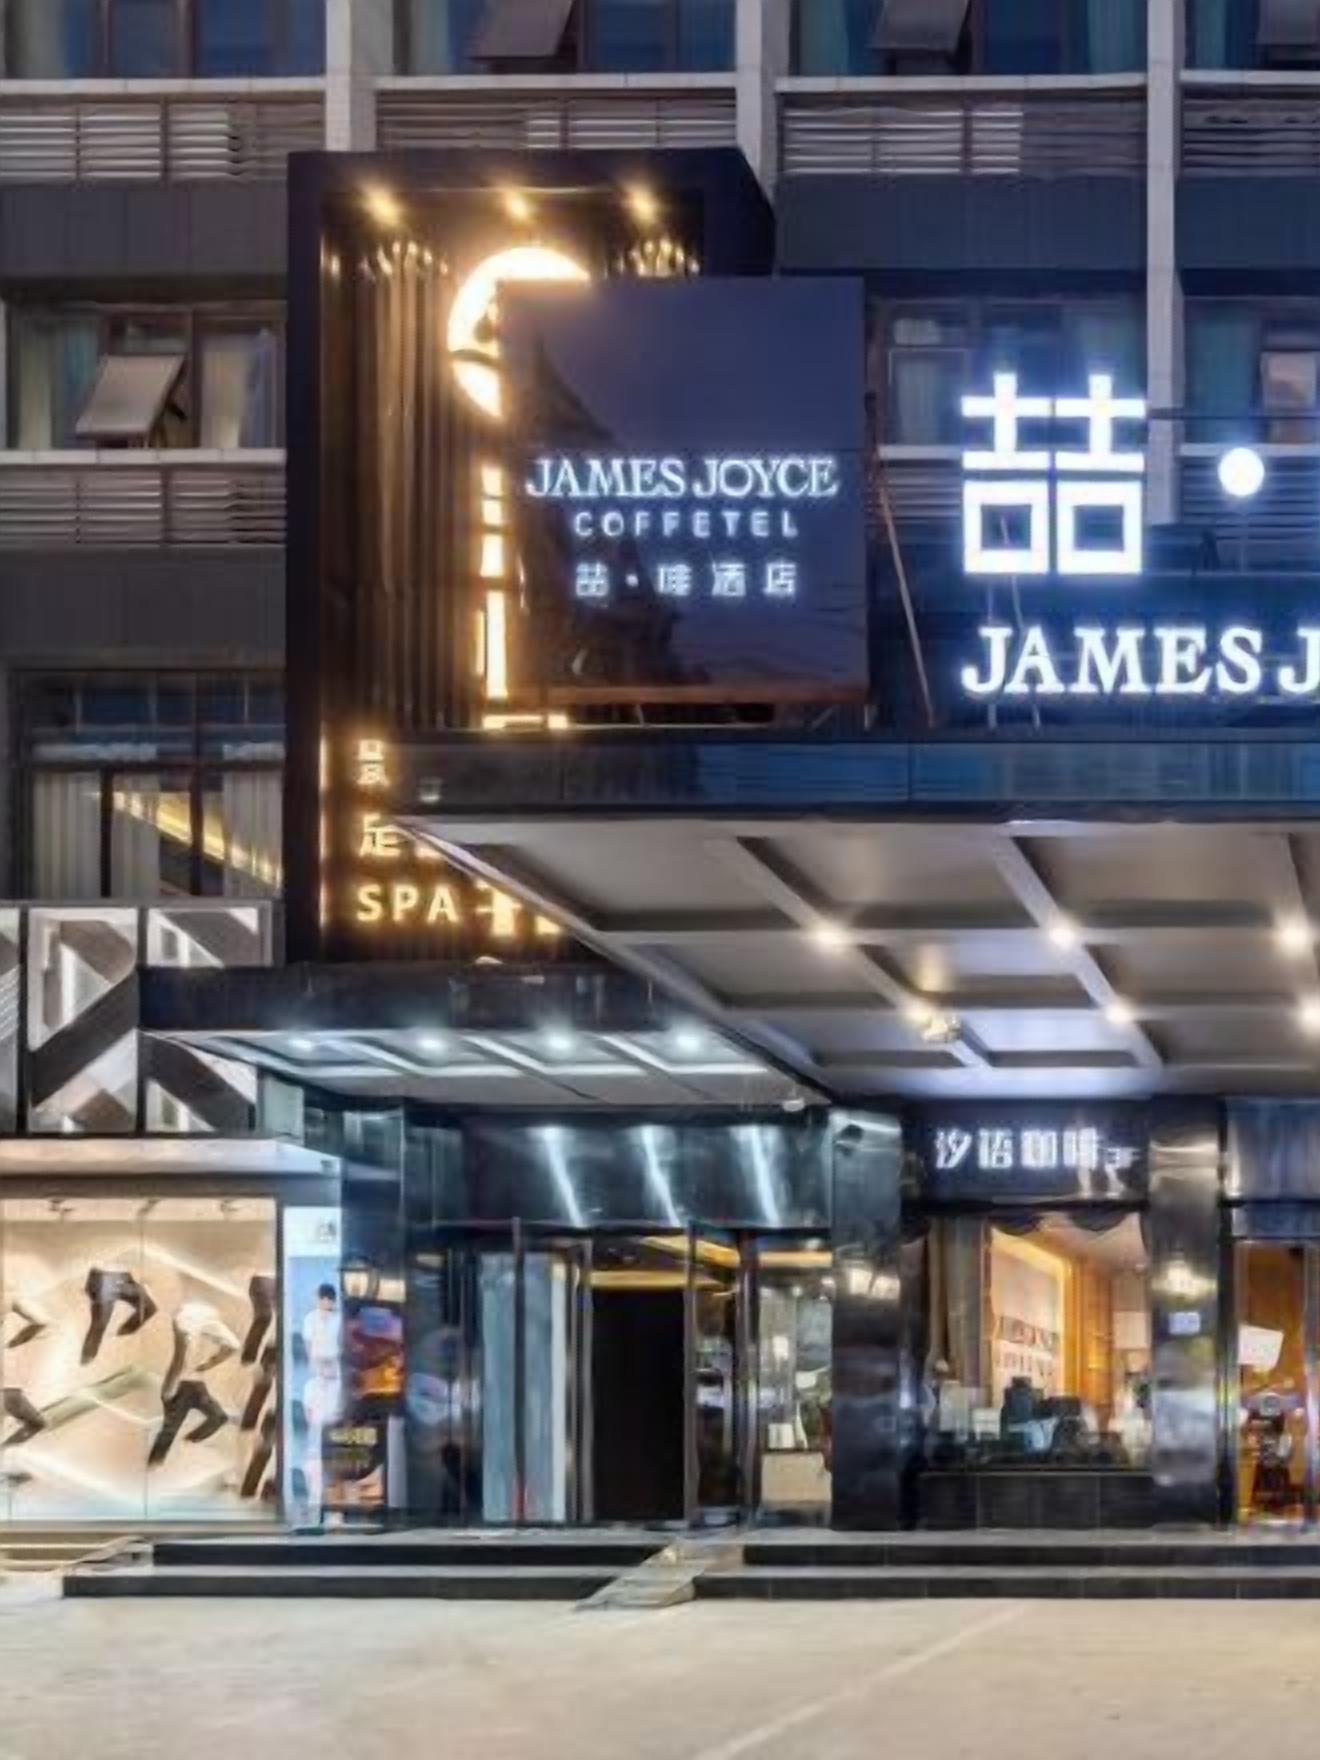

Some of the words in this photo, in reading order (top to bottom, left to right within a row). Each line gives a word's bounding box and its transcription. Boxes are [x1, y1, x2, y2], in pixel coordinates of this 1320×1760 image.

[525, 457, 687, 498] JAMES
[692, 455, 839, 498] JOYCE
[574, 510, 798, 538] COFFETEL
[963, 628, 1262, 695] JAMES
[357, 884, 460, 922] SPA
